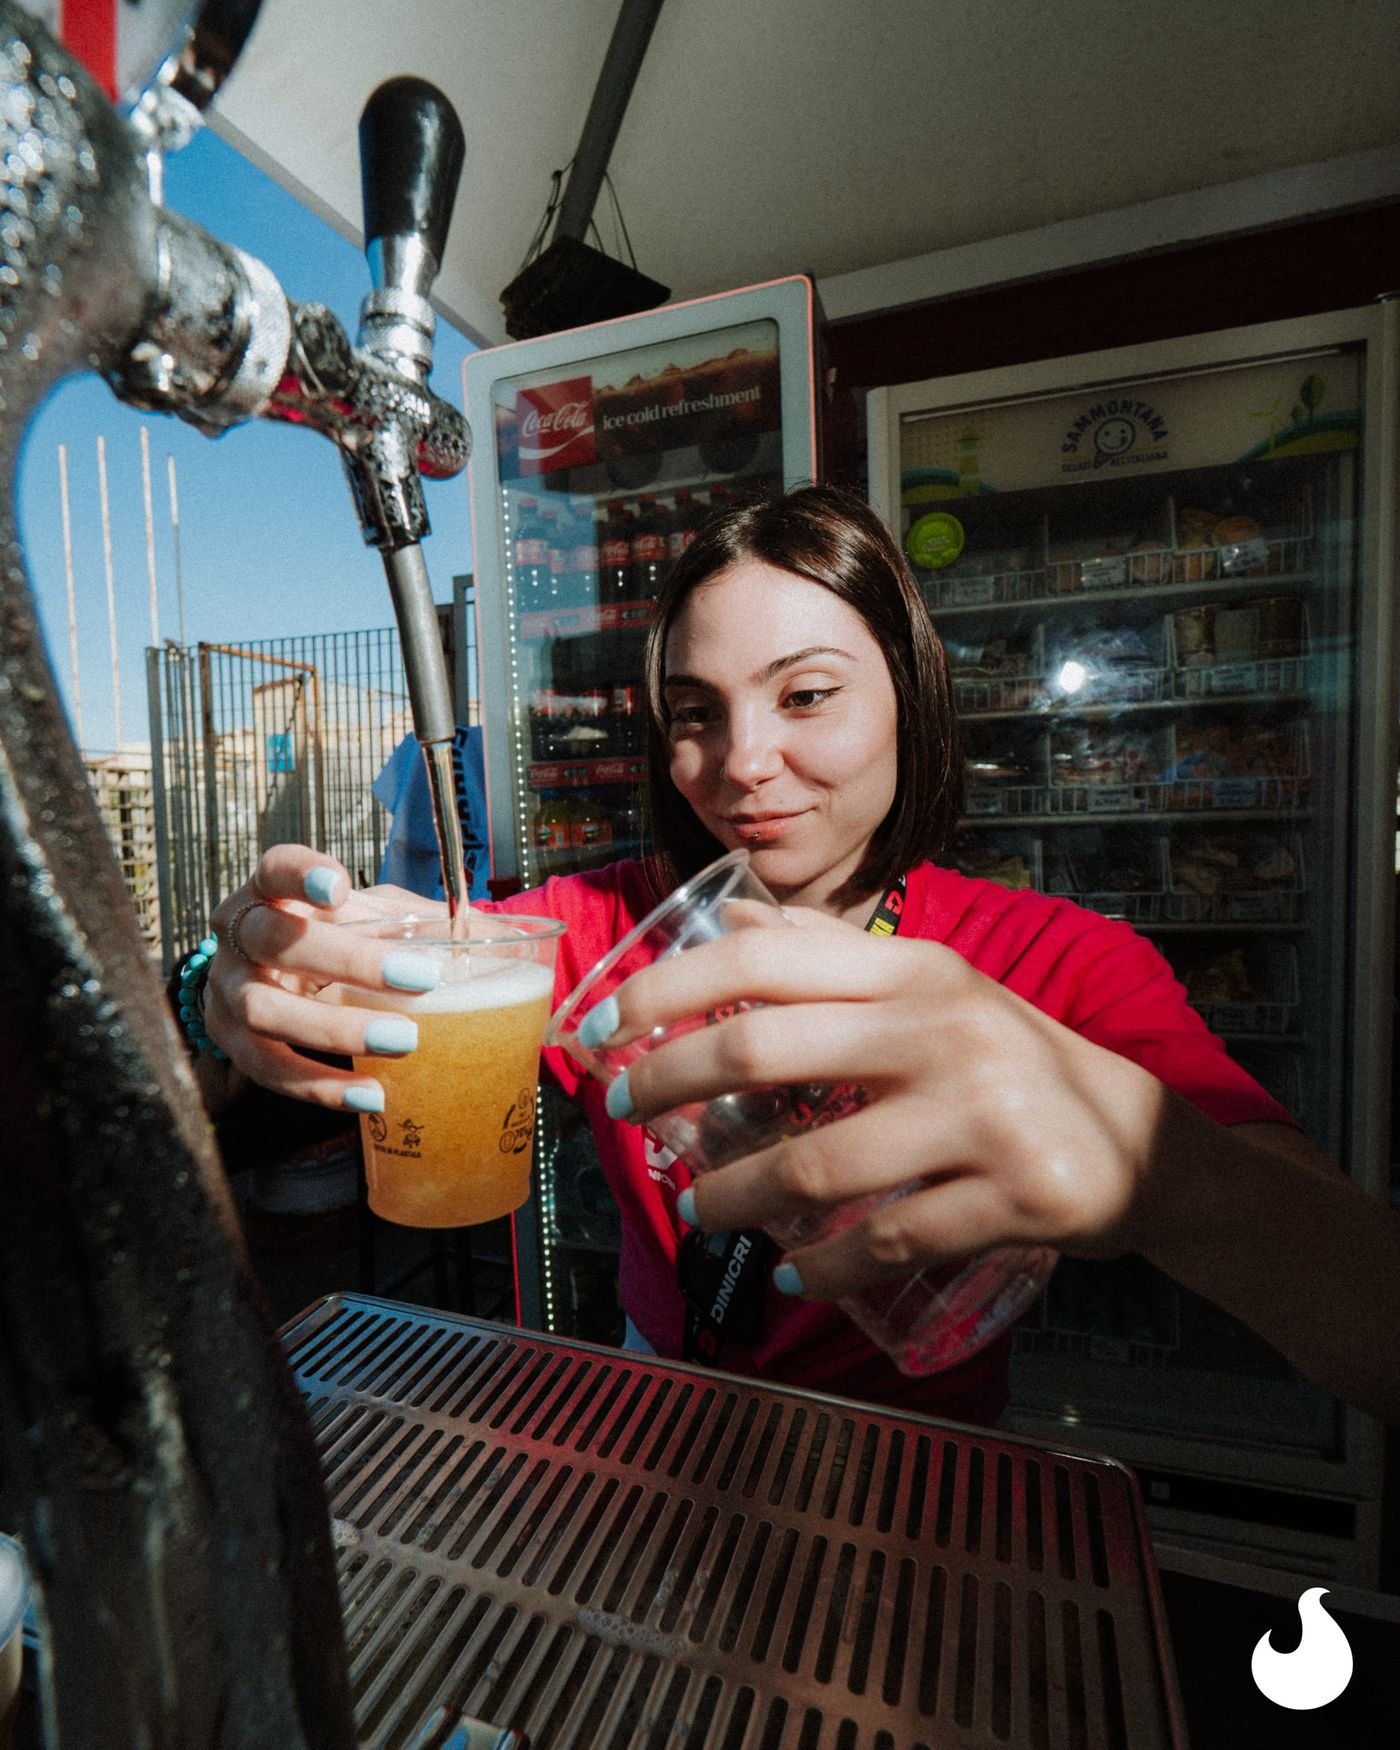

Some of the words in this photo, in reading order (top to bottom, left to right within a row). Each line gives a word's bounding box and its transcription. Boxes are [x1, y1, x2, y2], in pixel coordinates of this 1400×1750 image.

[603, 414, 625, 430] ice
[627, 404, 660, 426] cold
[661, 385, 761, 418] refreshment
[1061, 400, 1169, 453] SAMMONTANA
